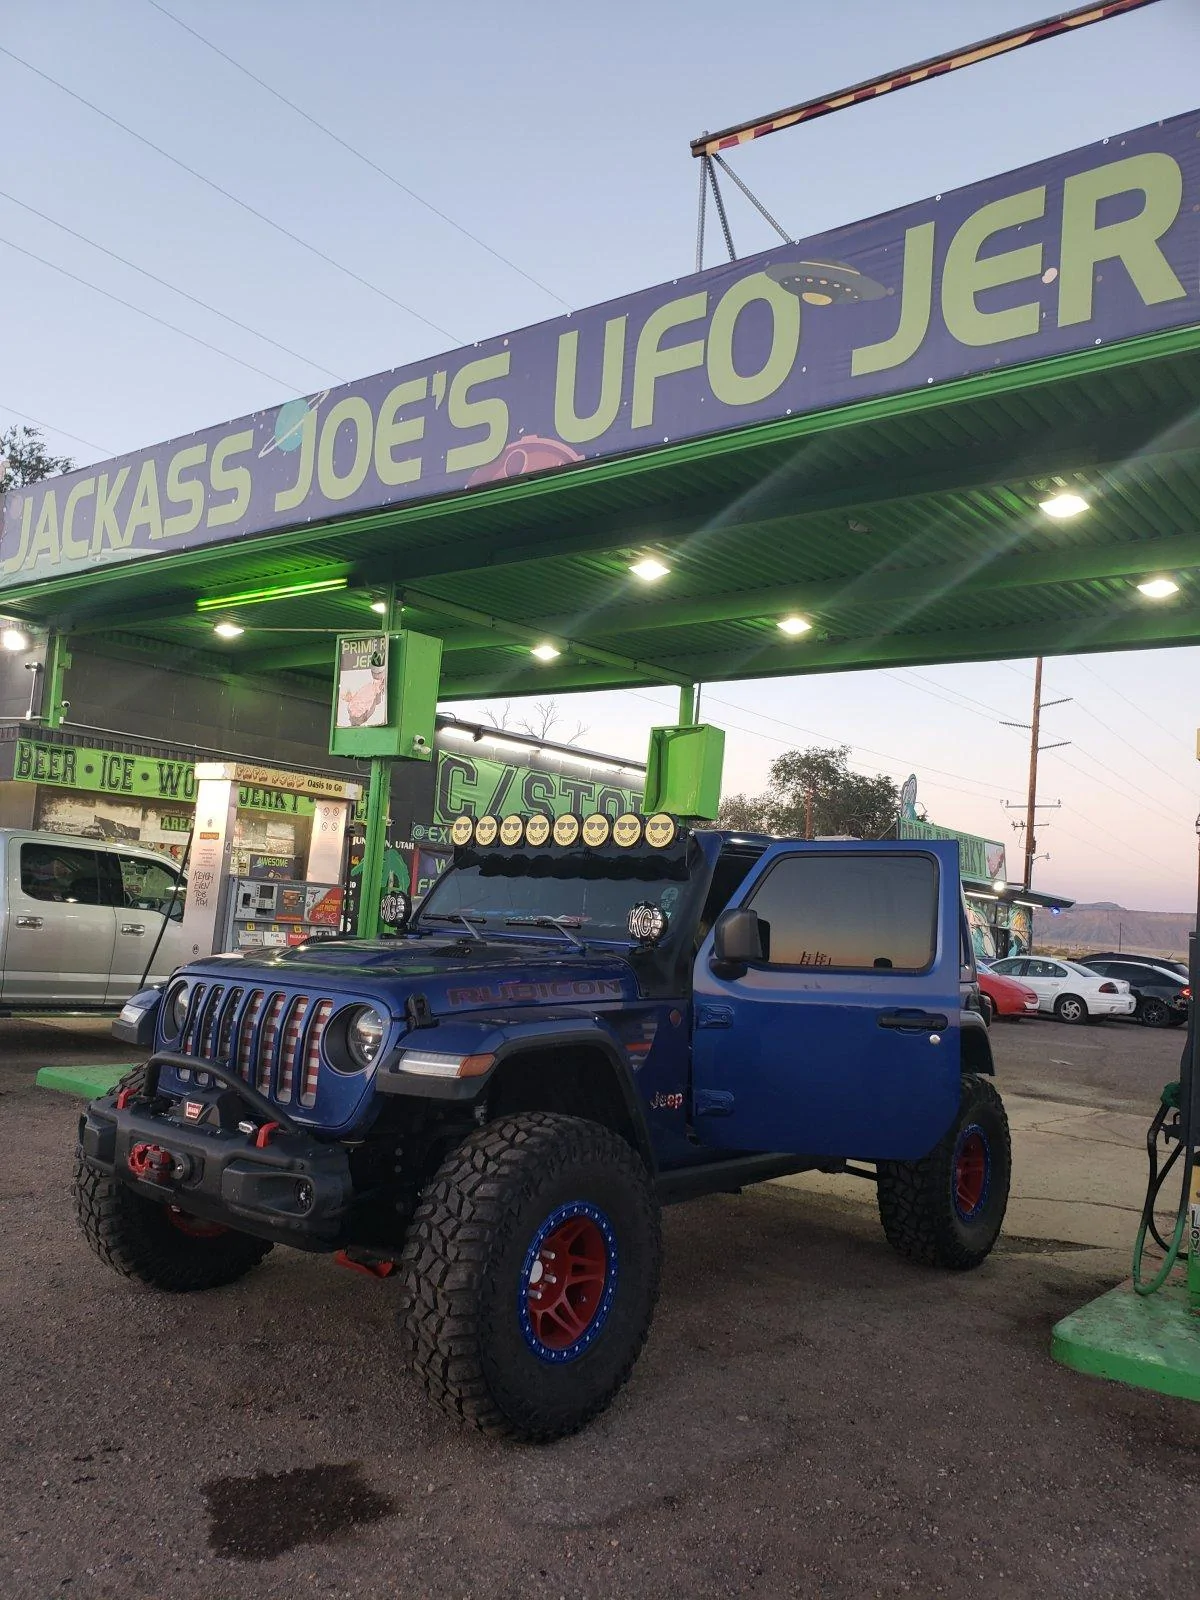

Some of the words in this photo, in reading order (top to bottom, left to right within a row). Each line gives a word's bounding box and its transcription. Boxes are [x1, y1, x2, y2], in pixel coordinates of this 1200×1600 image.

[3, 429, 254, 575] JACKASS
[275, 351, 511, 511] JOE'S
[554, 270, 801, 444] UFO
[851, 152, 1187, 377] JER
[17, 741, 76, 785] BEER
[100, 753, 135, 792] ICE
[158, 762, 195, 798] WO
[307, 779, 324, 790] Oasis
[326, 782, 333, 791] to
[334, 783, 343, 792] Go
[434, 753, 643, 823] C/STO
[395, 841, 414, 850] UTAH
[259, 856, 289, 869] AWESOME
[629, 906, 653, 938] KC
[446, 979, 622, 1005] RUBICON
[649, 1091, 683, 1109] Jeep
